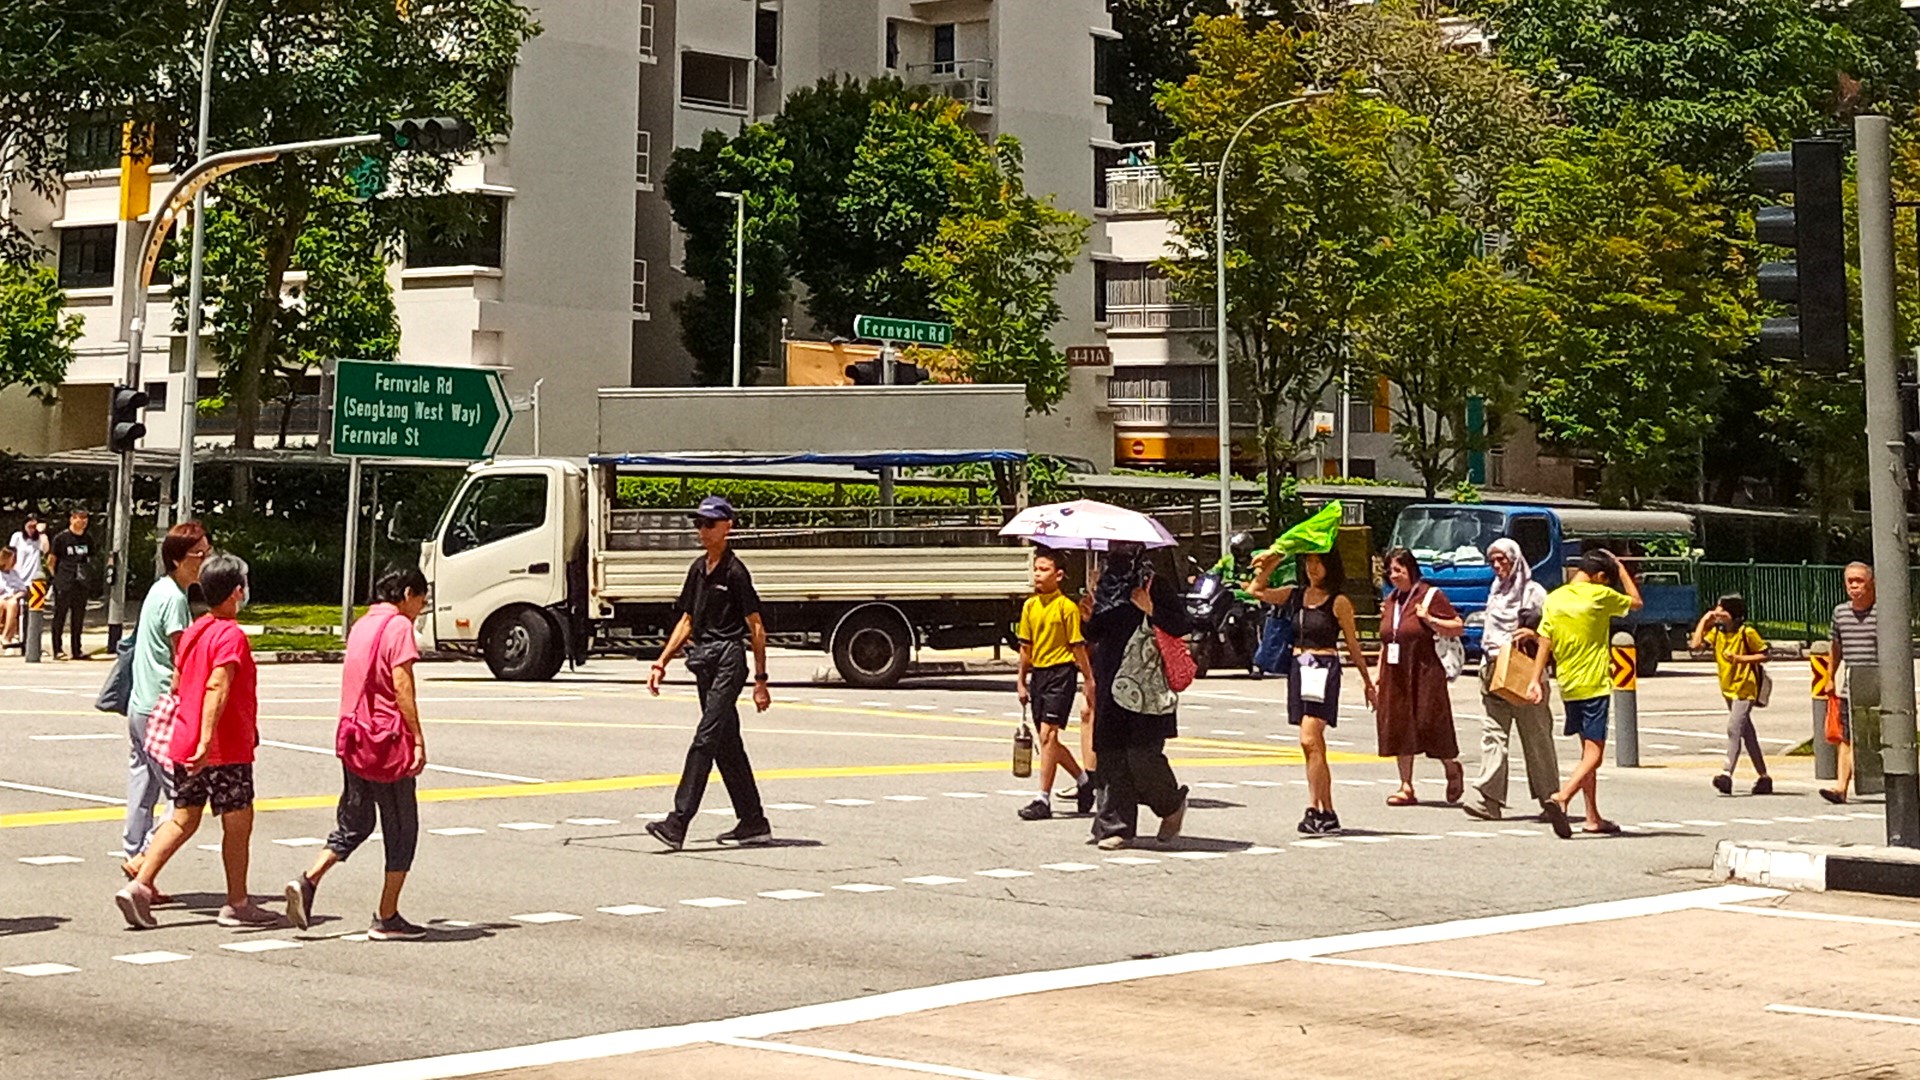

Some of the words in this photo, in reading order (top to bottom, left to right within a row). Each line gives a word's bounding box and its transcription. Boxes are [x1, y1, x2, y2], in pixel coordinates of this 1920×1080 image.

[863, 319, 924, 341] Fernvale
[928, 326, 945, 342] Rd
[1070, 349, 1105, 362] 441A
[374, 372, 430, 394] Fernvale
[436, 376, 453, 395] Rd
[343, 395, 409, 424] (Sengkang
[414, 401, 444, 421] West
[451, 403, 481, 427] Way)
[341, 424, 398, 445] Fernvale
[404, 426, 420, 446] St
